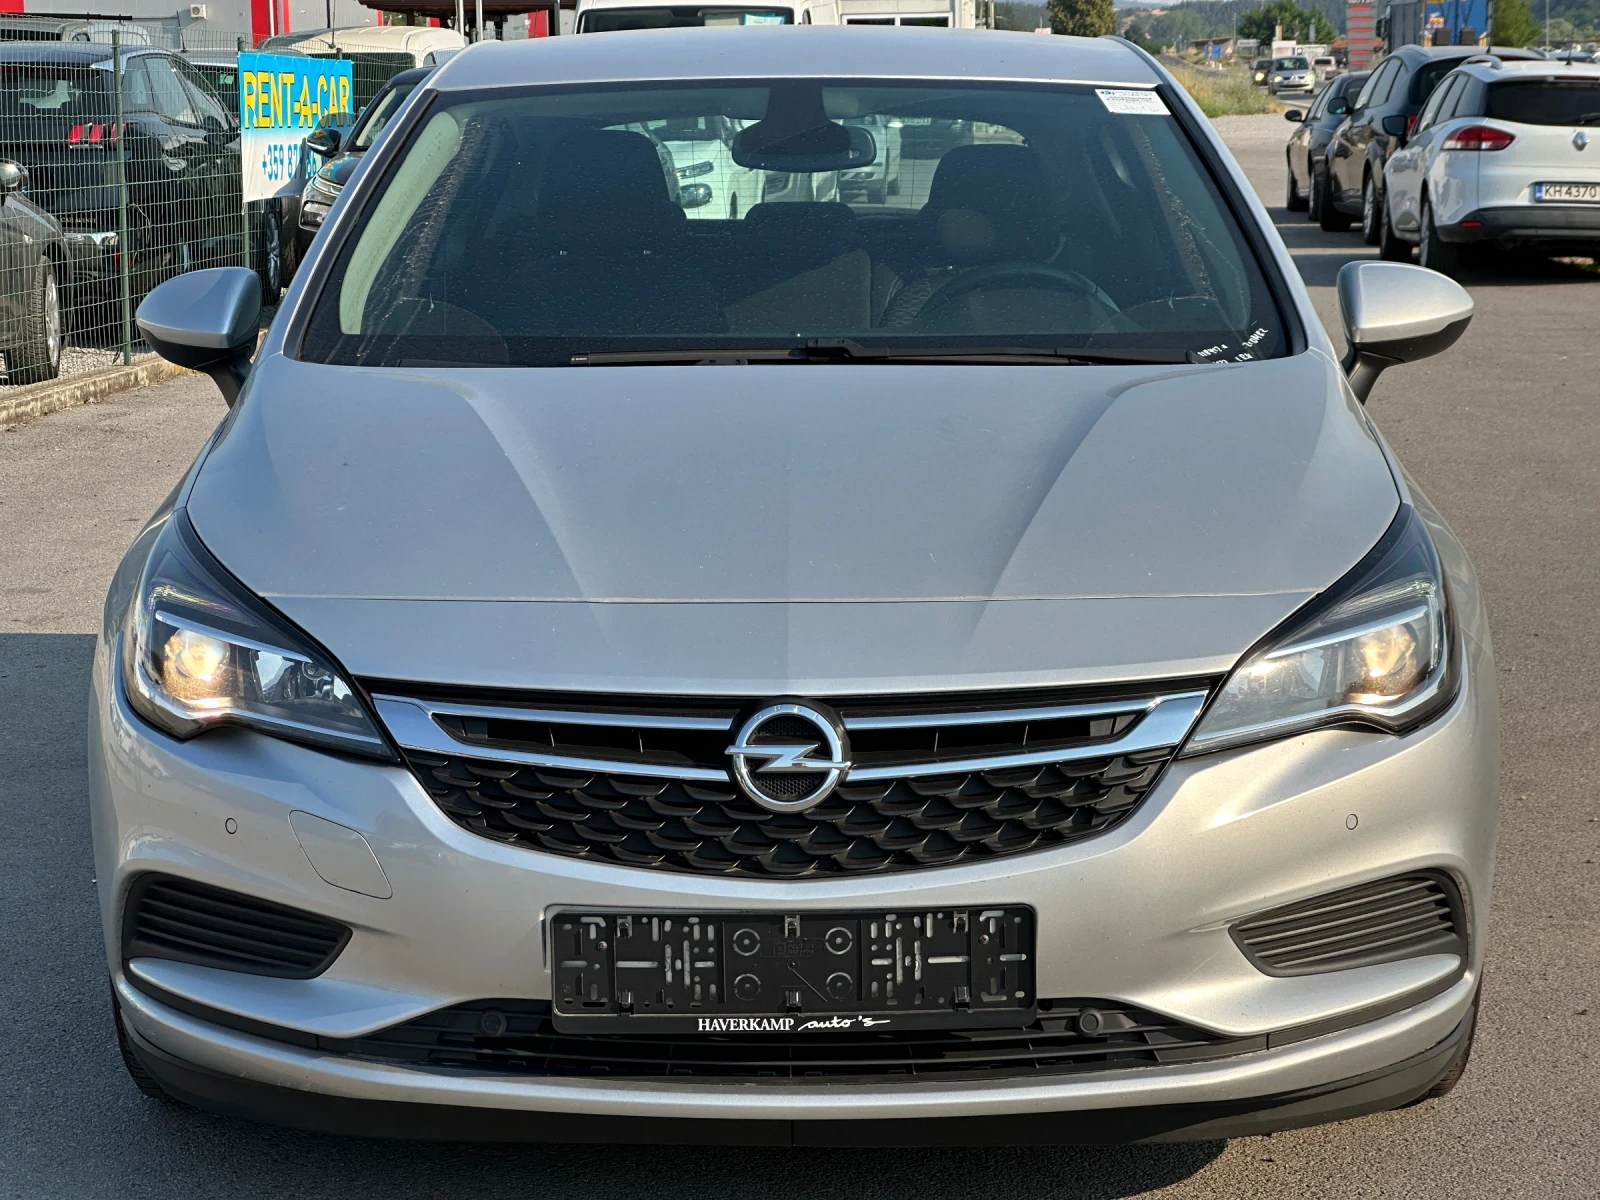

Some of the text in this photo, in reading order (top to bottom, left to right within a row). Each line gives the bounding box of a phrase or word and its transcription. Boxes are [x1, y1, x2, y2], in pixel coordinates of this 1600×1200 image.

[243, 71, 350, 129] RENT-A-CAR
[262, 144, 284, 181] +359
[1565, 185, 1597, 198] 4370
[698, 1018, 795, 1032] HAVERKAMP
